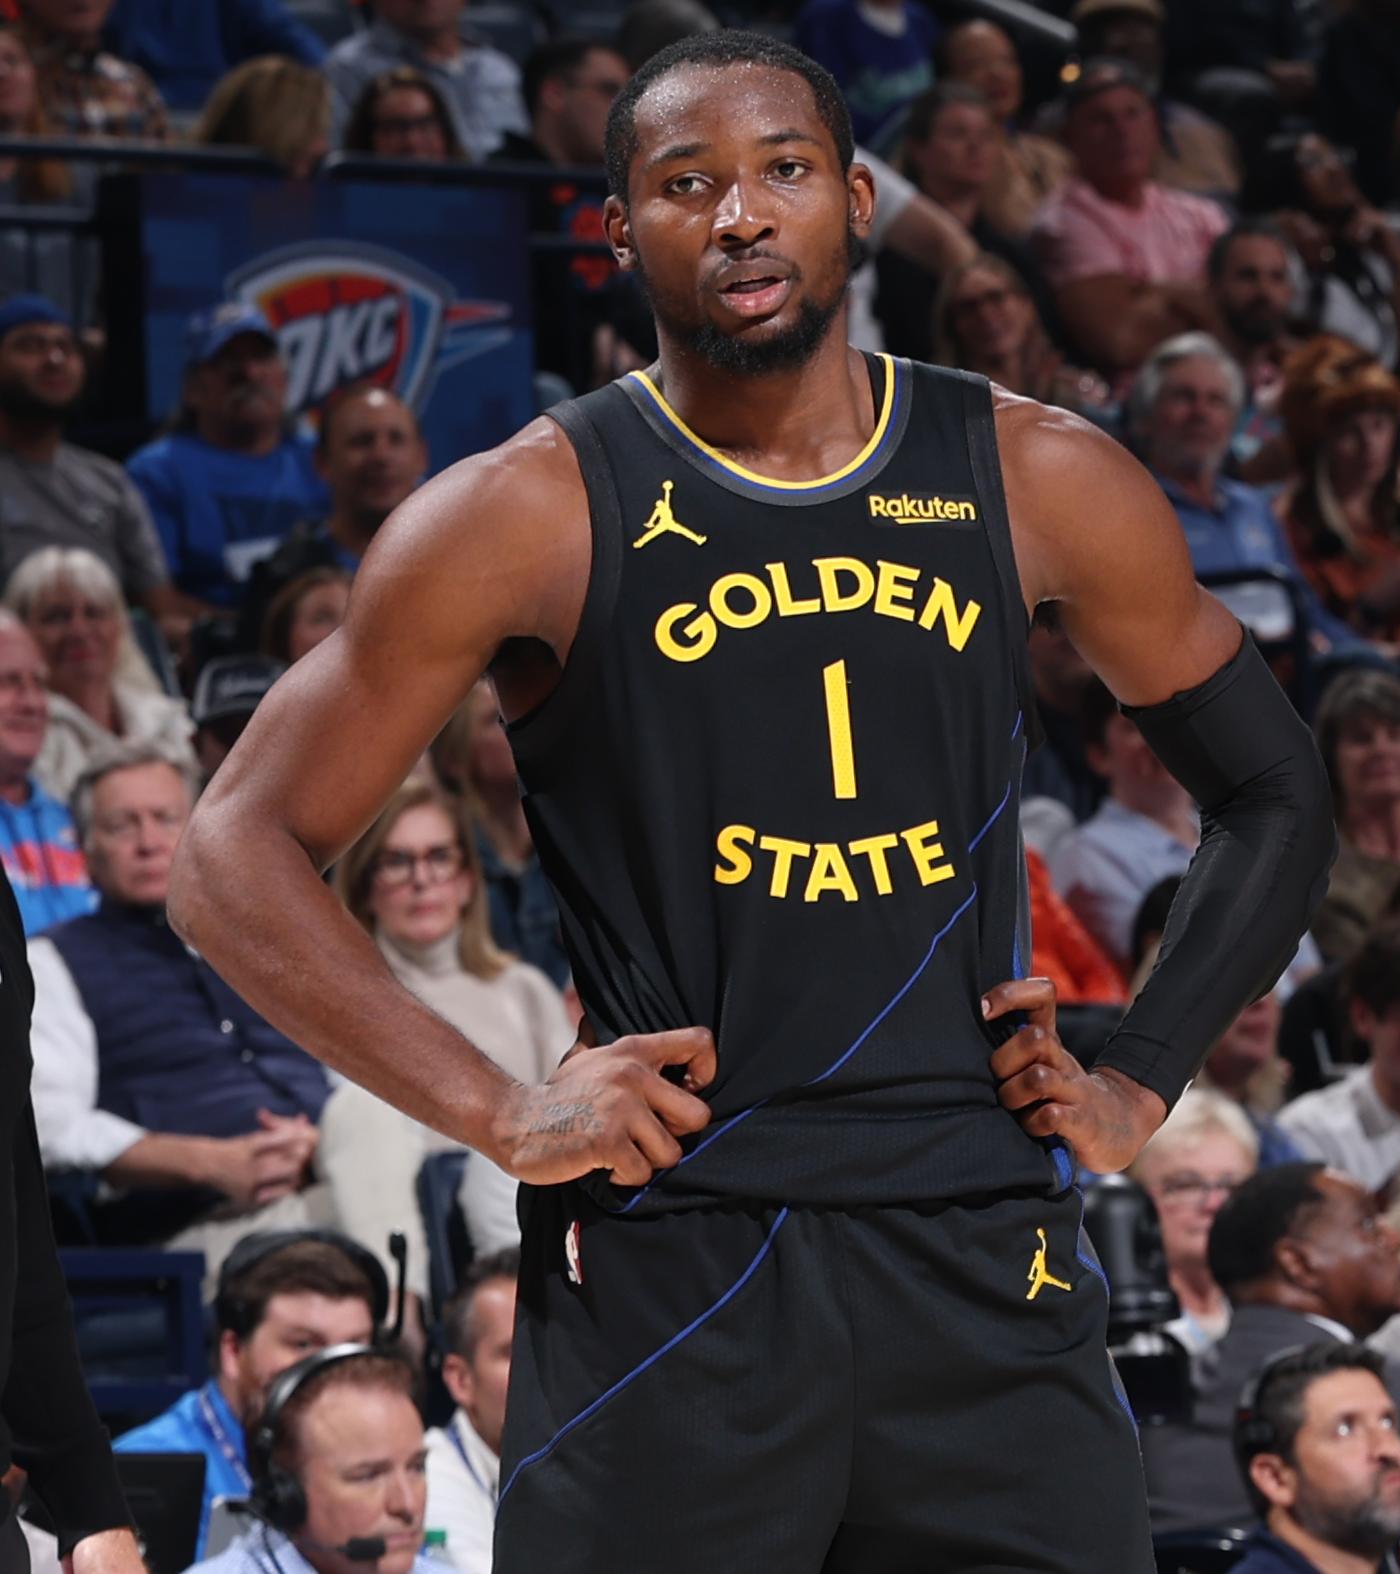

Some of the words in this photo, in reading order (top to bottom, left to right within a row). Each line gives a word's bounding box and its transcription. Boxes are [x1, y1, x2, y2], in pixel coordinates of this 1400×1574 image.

[868, 493, 977, 525] Rakuten
[654, 556, 982, 663] GOLDEN
[822, 659, 857, 800] 1
[714, 820, 956, 903] STATE
